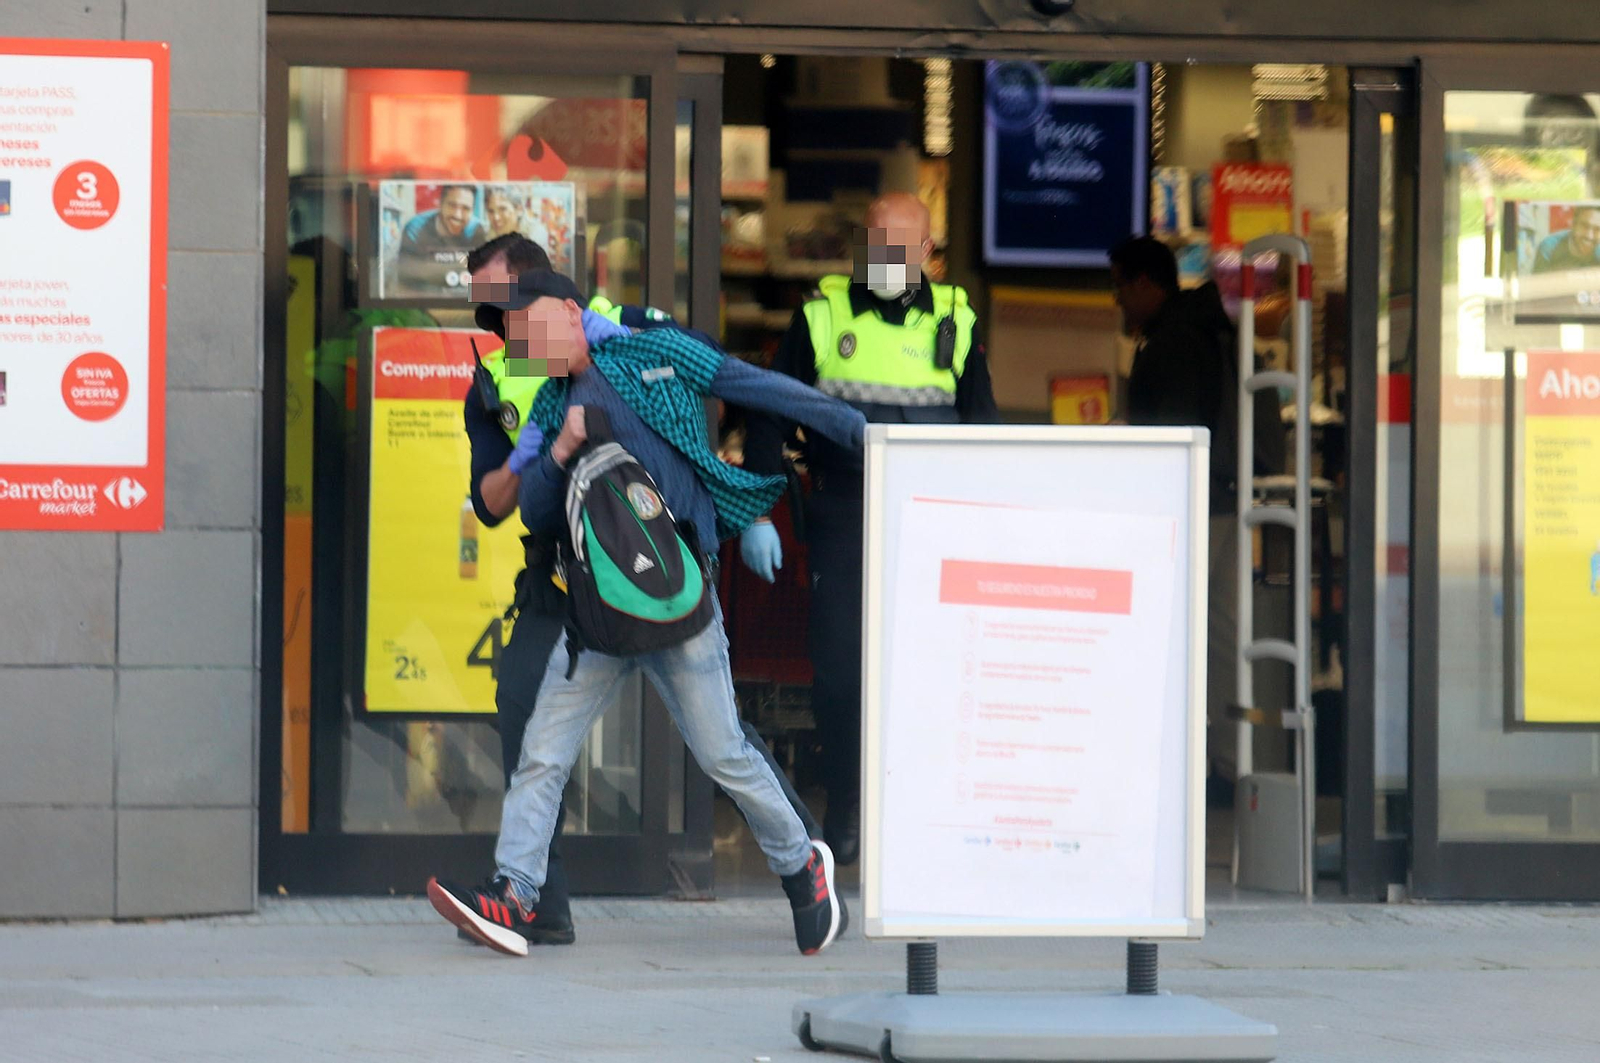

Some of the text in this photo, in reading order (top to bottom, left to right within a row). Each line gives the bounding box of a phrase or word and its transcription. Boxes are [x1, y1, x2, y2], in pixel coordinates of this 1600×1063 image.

[18, 105, 74, 118] compras
[76, 172, 98, 199] 3
[14, 311, 91, 328] especiales
[76, 367, 114, 380] SIN IVA
[70, 386, 120, 400] OFERTAS
[0, 477, 98, 501] Carrefour
[38, 500, 97, 518] market
